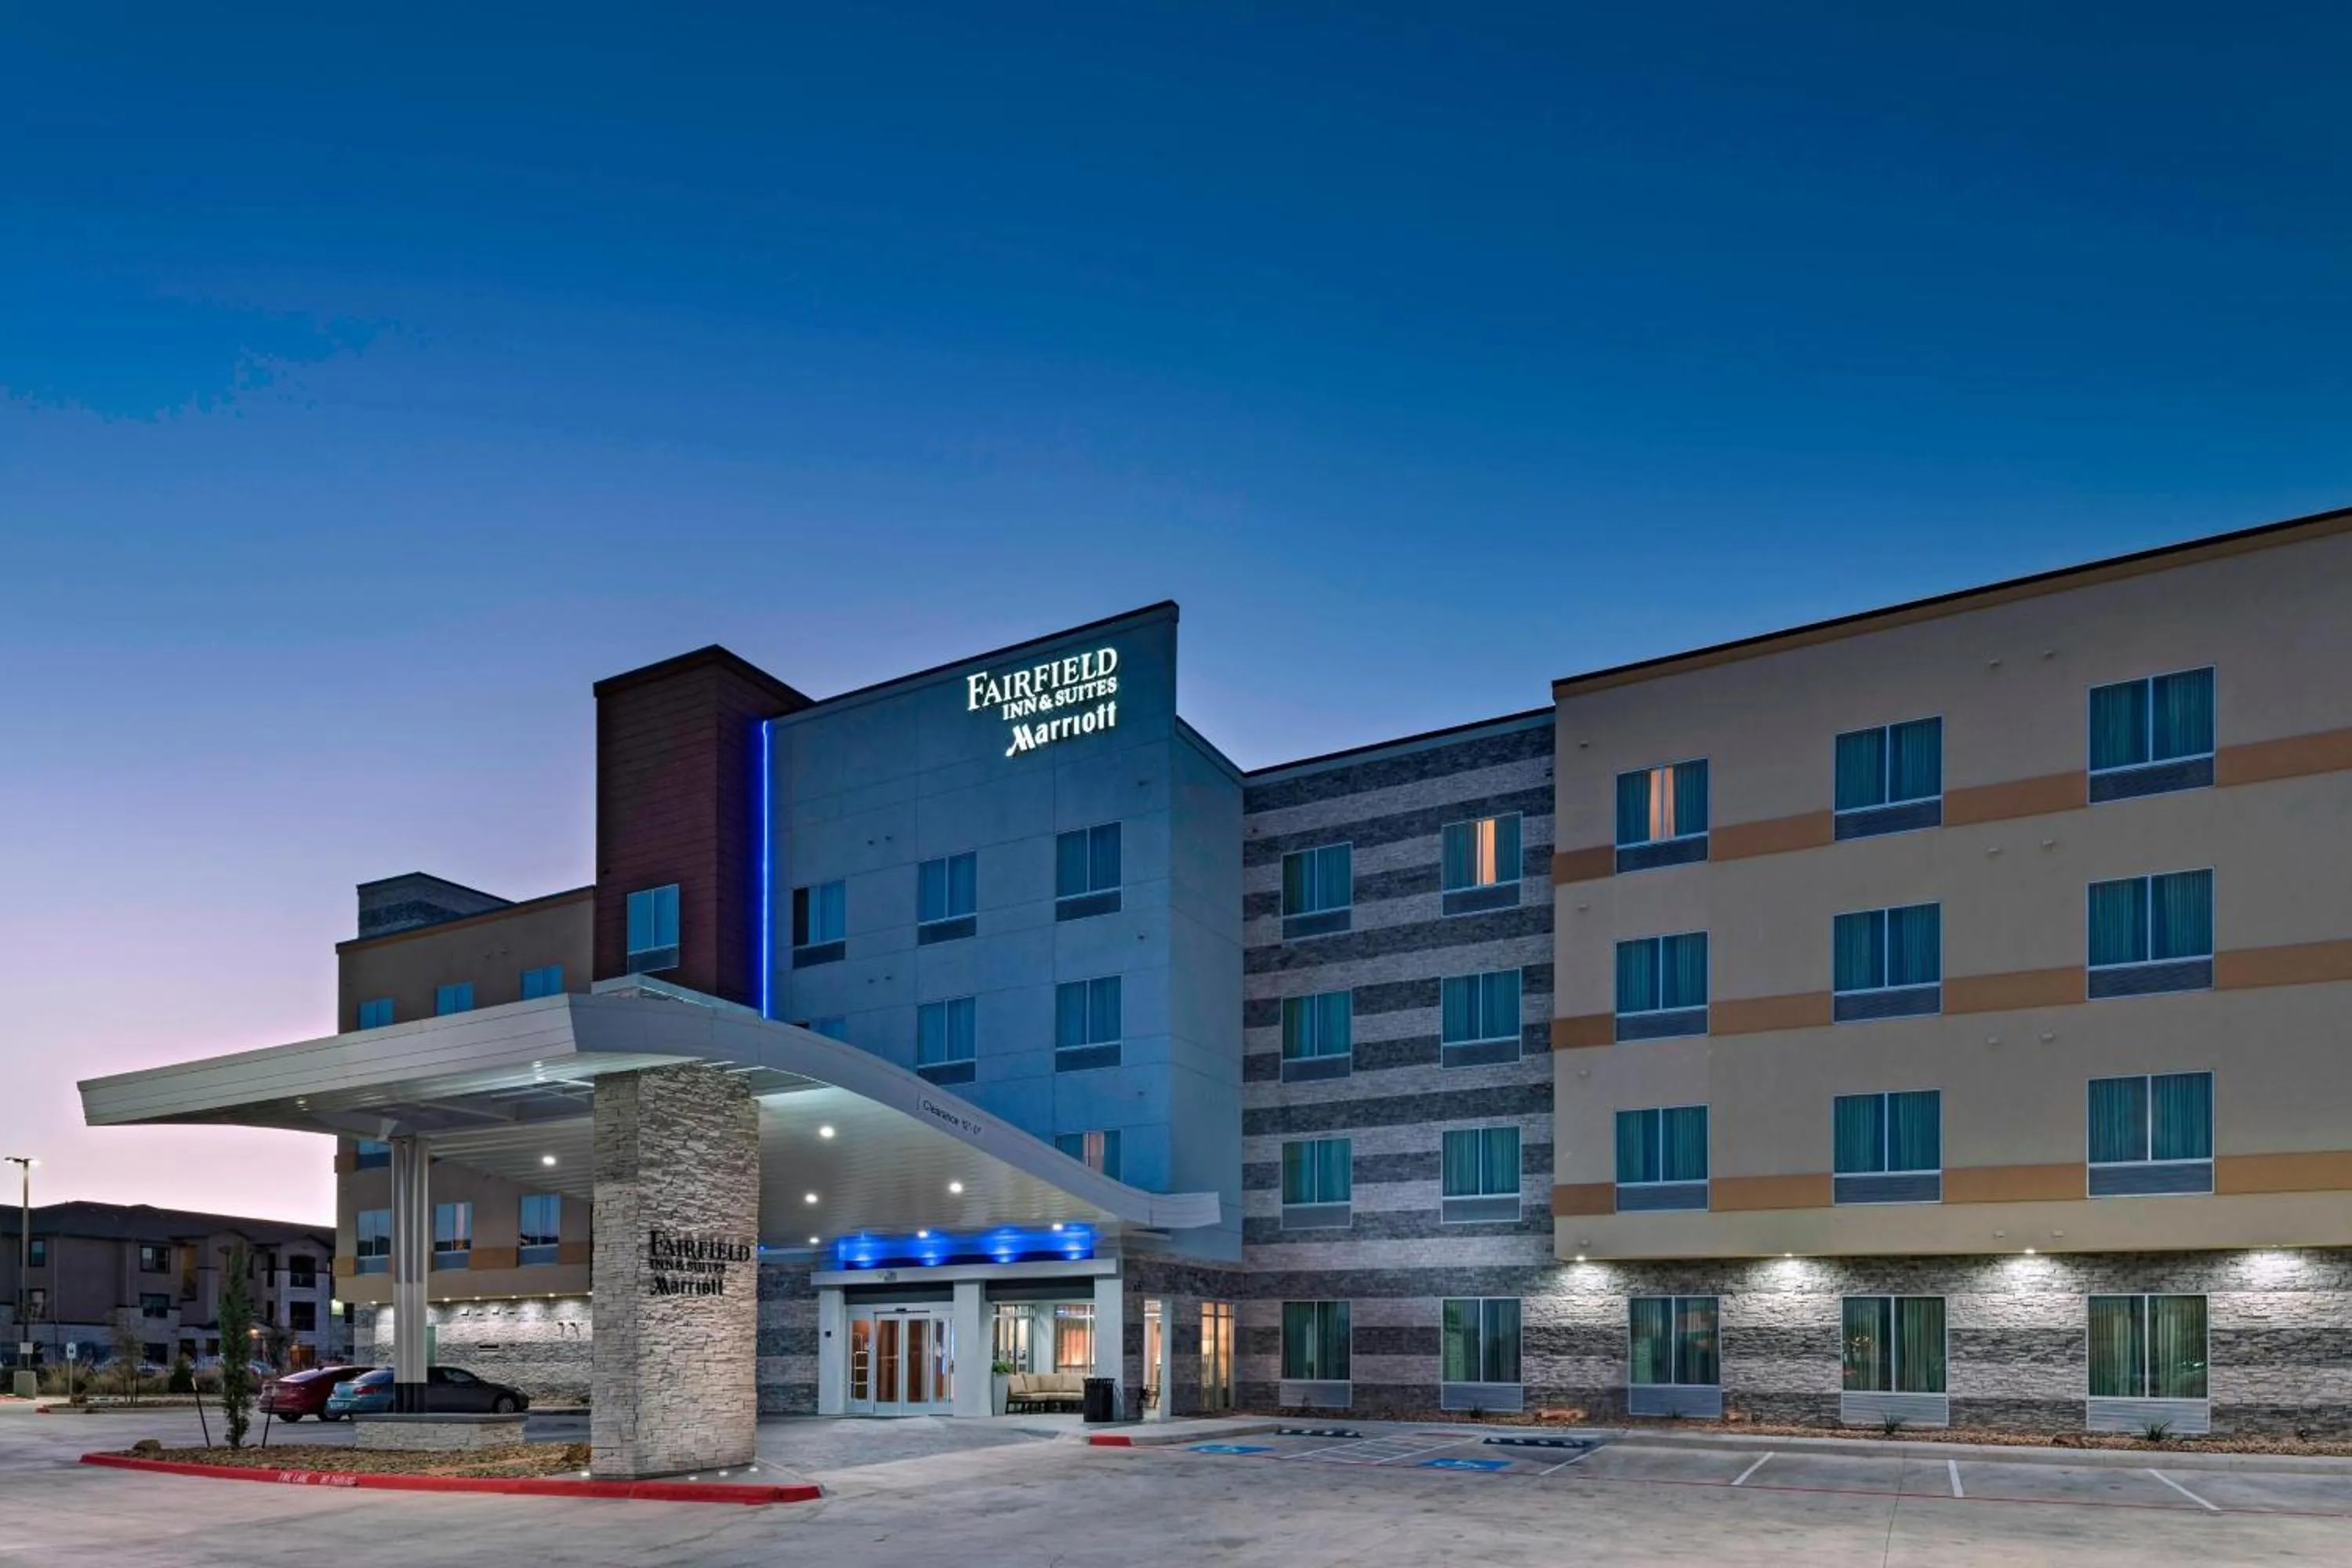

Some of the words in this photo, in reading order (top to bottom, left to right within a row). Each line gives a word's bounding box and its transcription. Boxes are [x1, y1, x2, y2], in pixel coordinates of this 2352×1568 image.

[967, 647, 1118, 711] FAIRFIELD
[1003, 699, 1037, 720] INN
[1054, 676, 1117, 706] SUITES
[1004, 700, 1117, 757] Marriott
[650, 1230, 750, 1261] FAIRFIELD
[650, 1276, 724, 1295] Marriott
